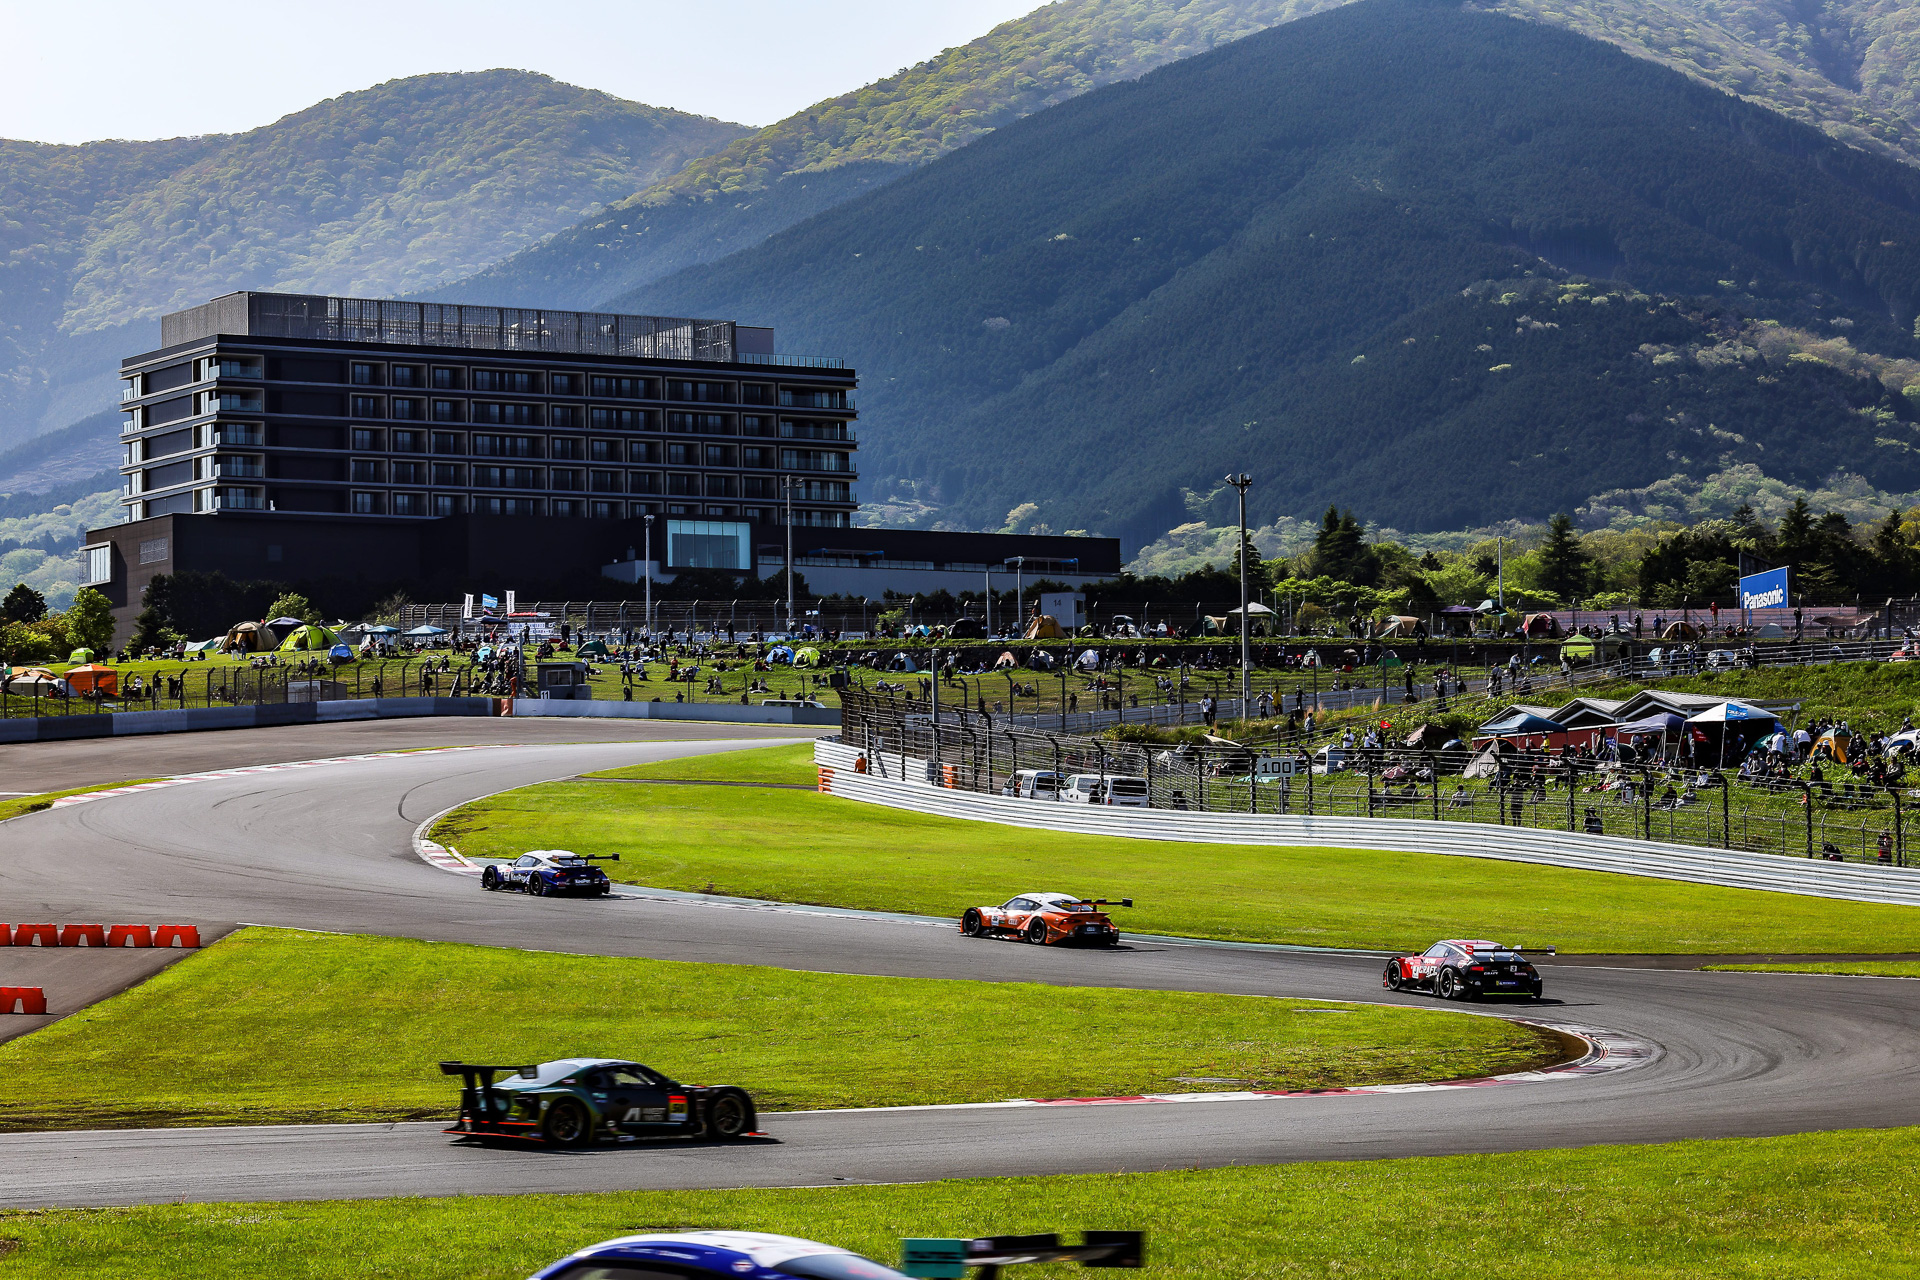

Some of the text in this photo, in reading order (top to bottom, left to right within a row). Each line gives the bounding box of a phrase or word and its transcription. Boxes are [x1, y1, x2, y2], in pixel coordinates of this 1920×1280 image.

[1743, 584, 1784, 610] Panasonic
[1053, 599, 1062, 607] 14
[541, 690, 549, 700] 11
[1261, 761, 1292, 774] 100
